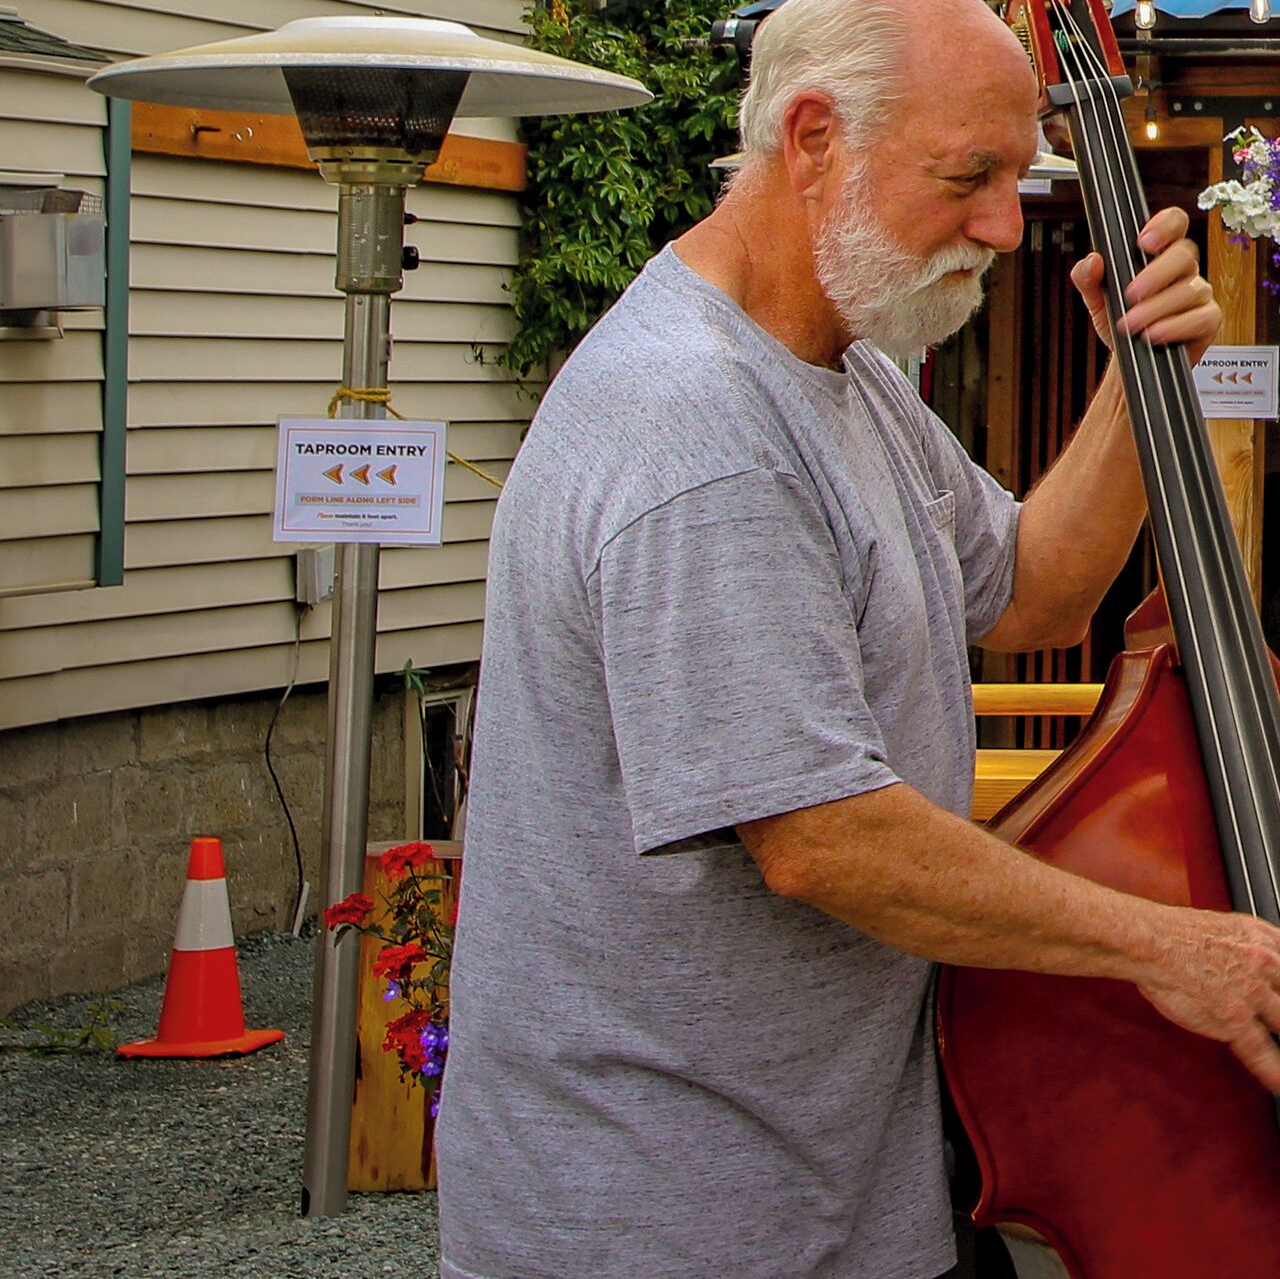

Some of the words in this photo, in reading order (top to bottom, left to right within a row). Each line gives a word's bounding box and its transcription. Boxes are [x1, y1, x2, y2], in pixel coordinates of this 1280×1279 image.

[1240, 360, 1269, 368] ENTRY
[295, 443, 372, 456] TAPROOM
[376, 444, 427, 457] ENTRY
[397, 497, 417, 505] SIDE
